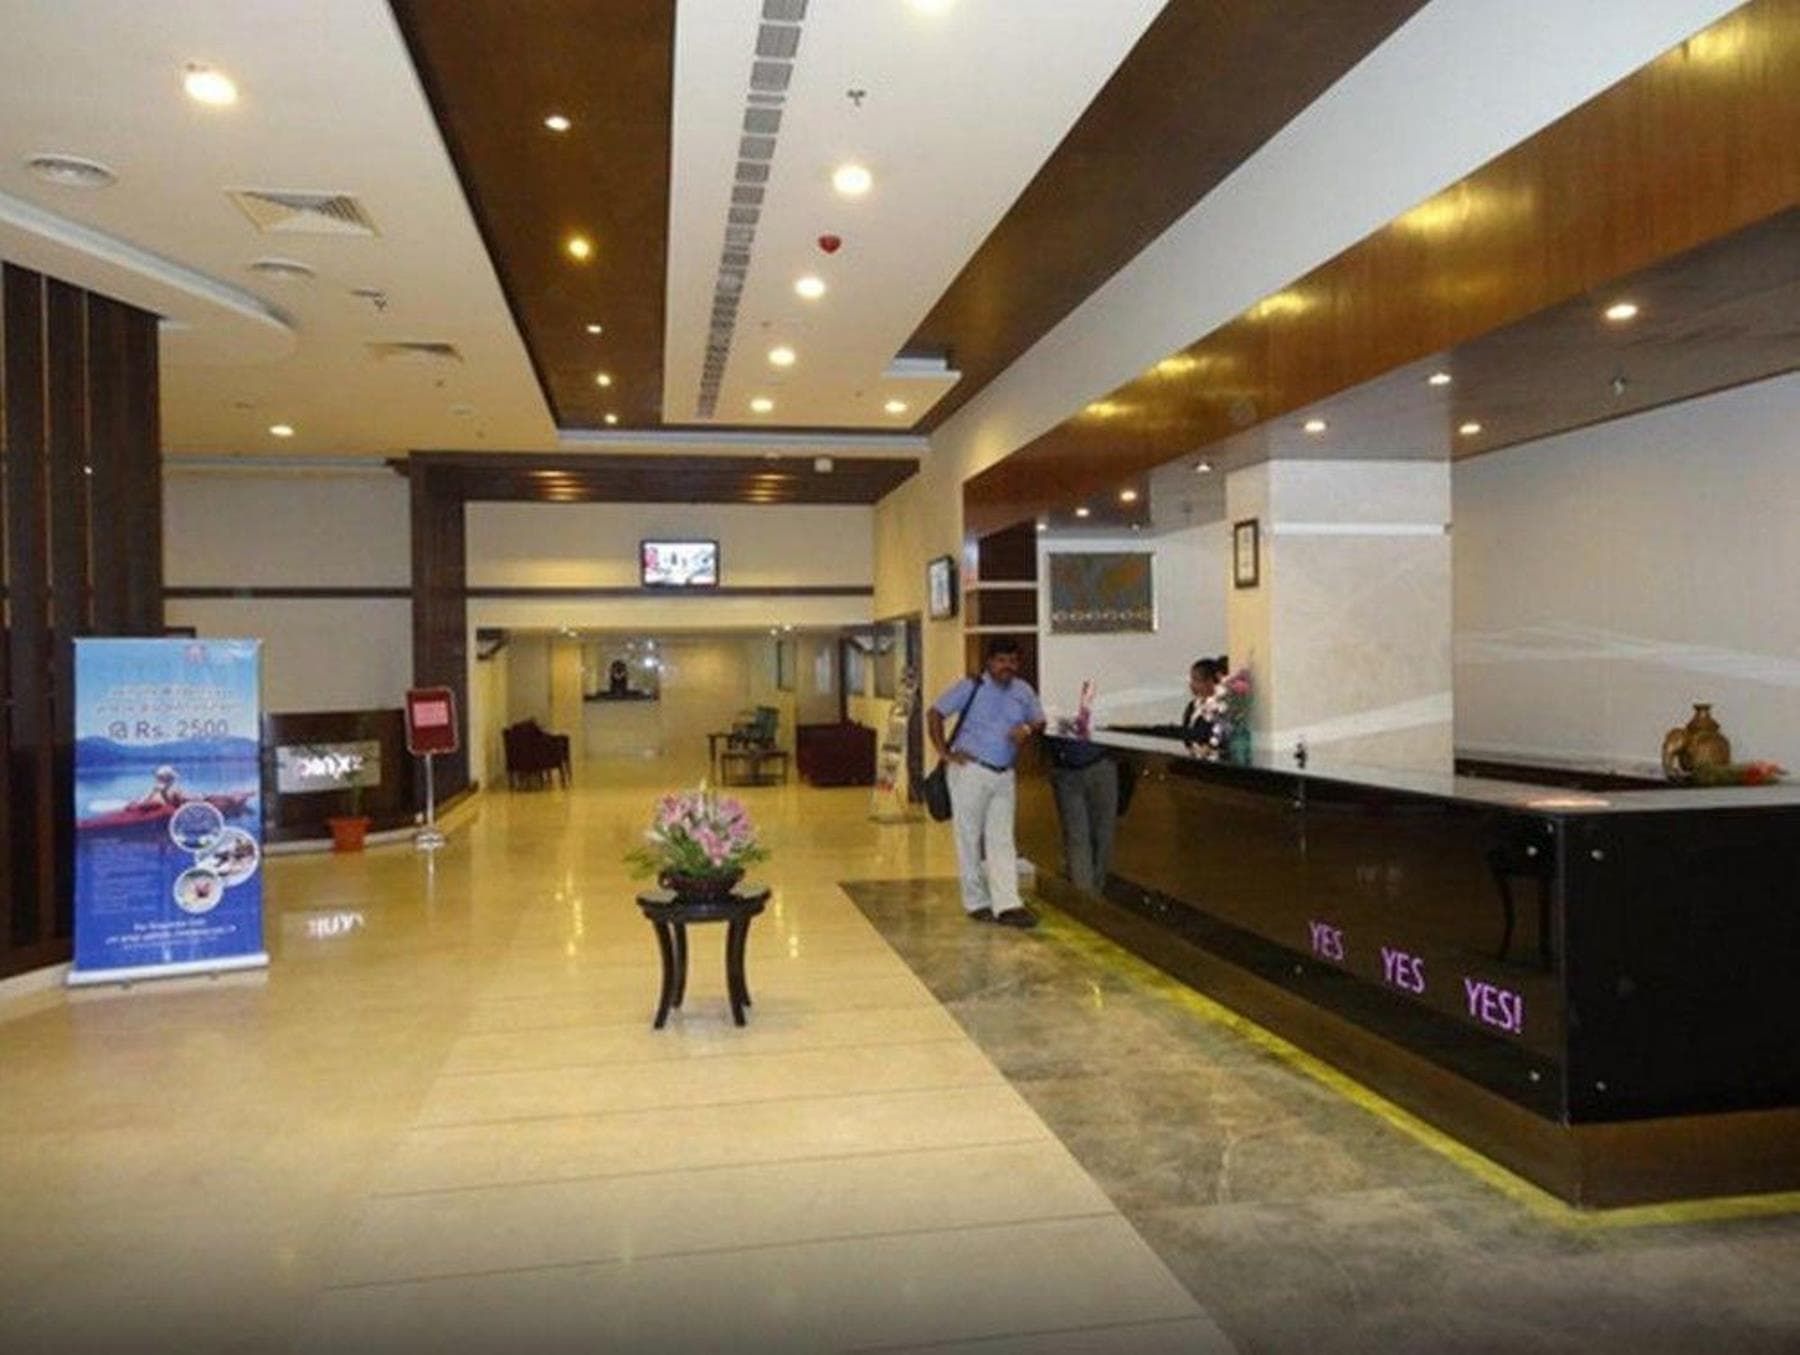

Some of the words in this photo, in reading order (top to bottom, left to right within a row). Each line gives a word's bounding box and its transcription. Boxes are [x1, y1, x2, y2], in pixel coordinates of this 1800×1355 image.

[136, 720, 173, 738] Rs.
[176, 718, 229, 738] 2500
[1309, 920, 1344, 960] YES
[1381, 946, 1425, 994] YES
[1464, 977, 1522, 1034] YES!
